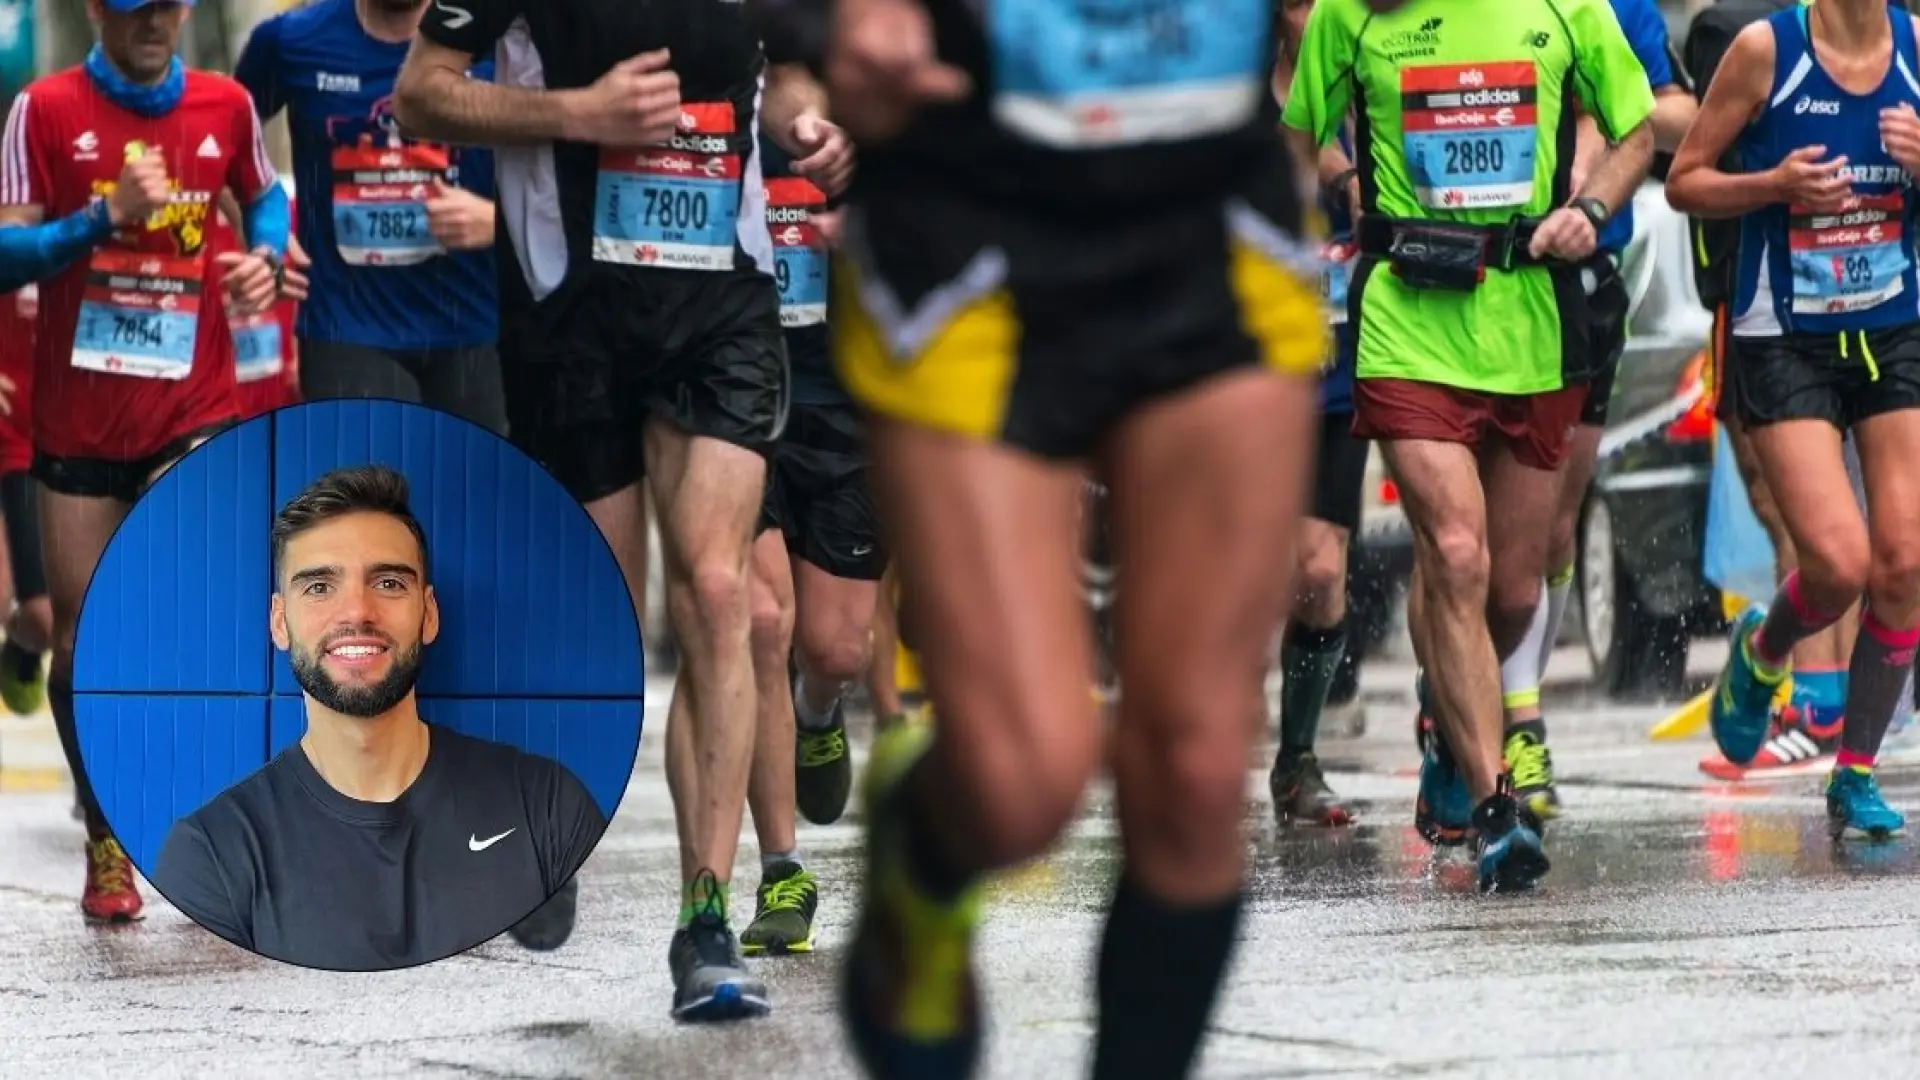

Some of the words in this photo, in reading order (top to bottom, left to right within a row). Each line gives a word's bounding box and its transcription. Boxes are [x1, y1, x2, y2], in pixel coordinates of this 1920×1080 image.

[1463, 88, 1520, 106] adidas
[1810, 100, 1839, 114] asics
[671, 135, 727, 152] adidas
[1445, 139, 1503, 174] 2880
[643, 188, 707, 230] 7800
[367, 211, 417, 239] 7882
[111, 316, 163, 347] 7854
